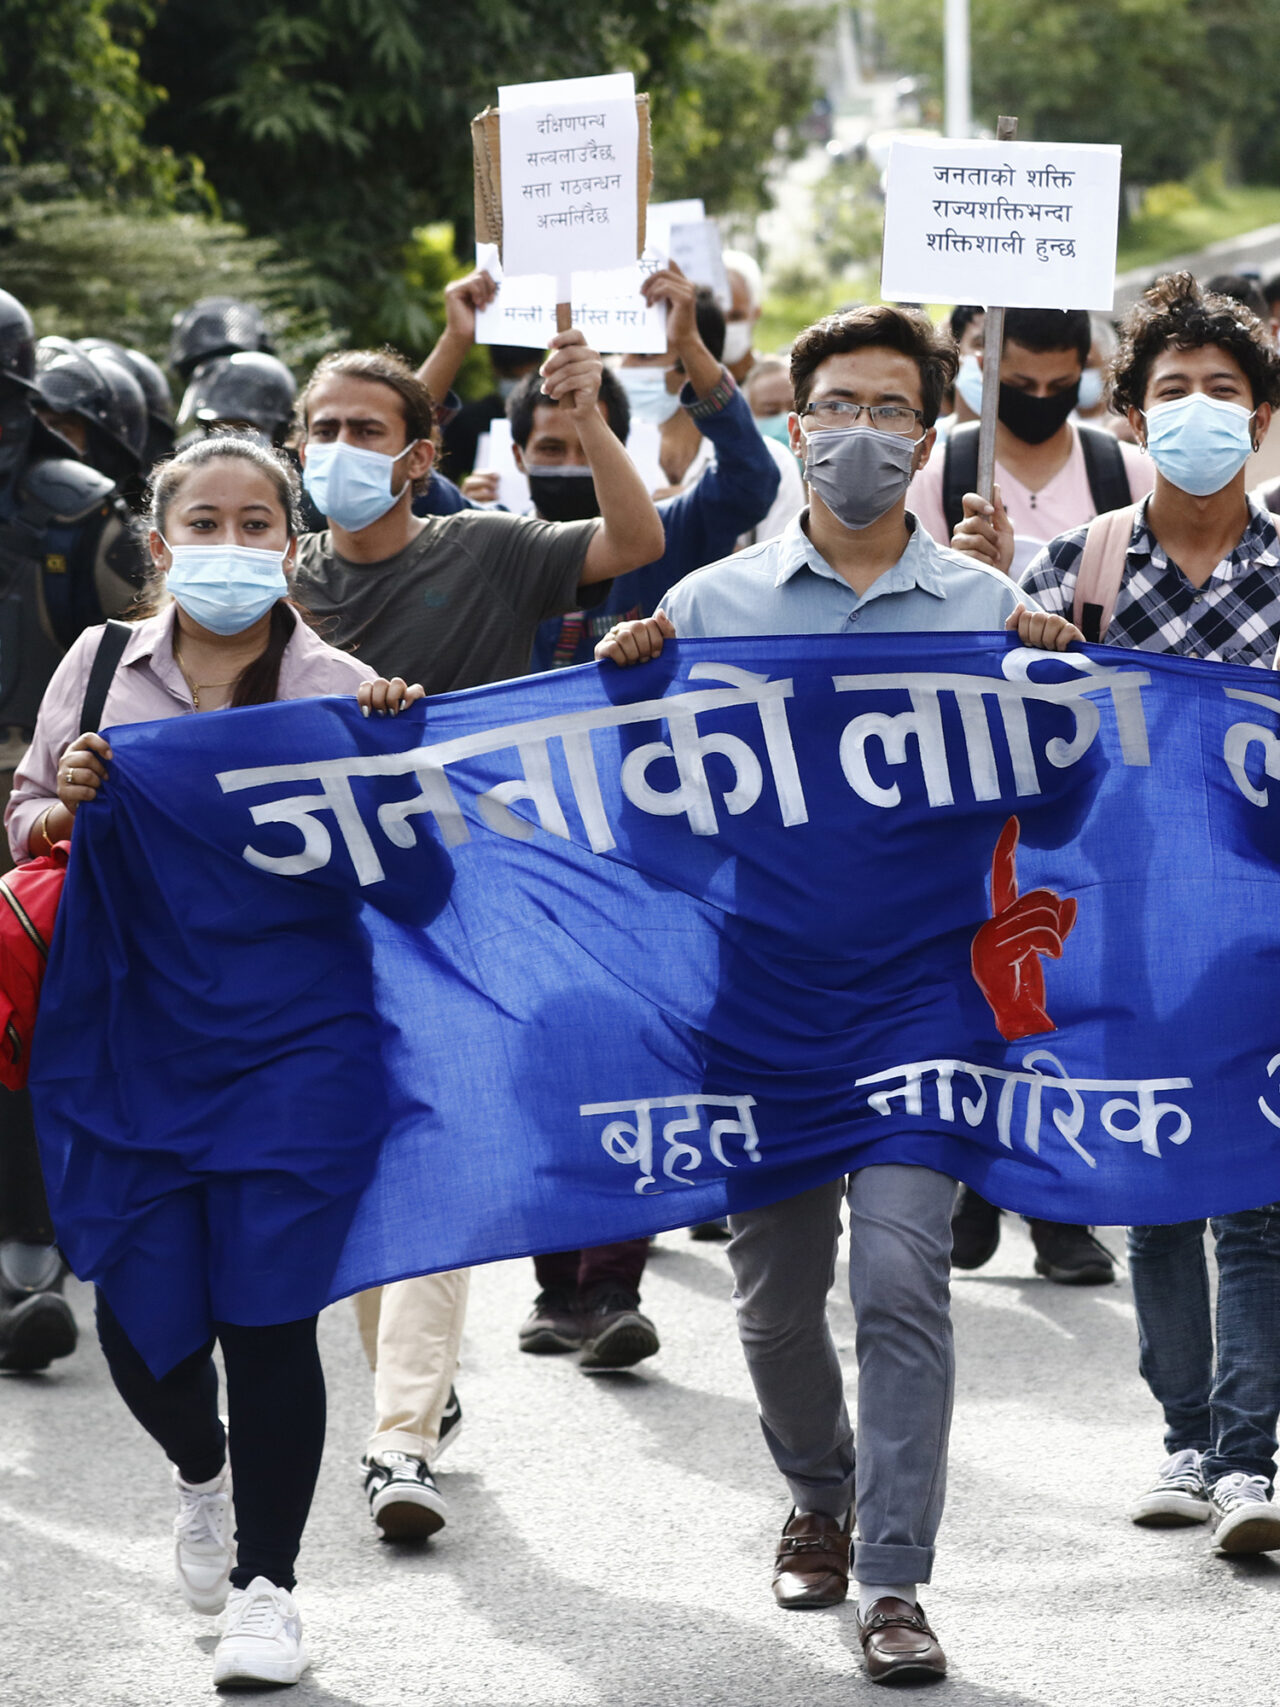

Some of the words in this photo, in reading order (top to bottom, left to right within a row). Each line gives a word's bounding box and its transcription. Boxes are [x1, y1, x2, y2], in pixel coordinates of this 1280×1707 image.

[521, 182, 552, 199] सत्ता
[560, 174, 621, 195] गठबन्धन
[933, 163, 1016, 187] जनताको
[1026, 164, 1076, 189] शक्ति
[932, 196, 1073, 223] राज्यशक्तिभन्दा
[926, 228, 1025, 255] शक्तिशाली
[1035, 238, 1076, 262] हुन्छ
[216, 662, 809, 887] जनताको
[833, 647, 1151, 809] लागि
[855, 1050, 1193, 1169] नागरिक
